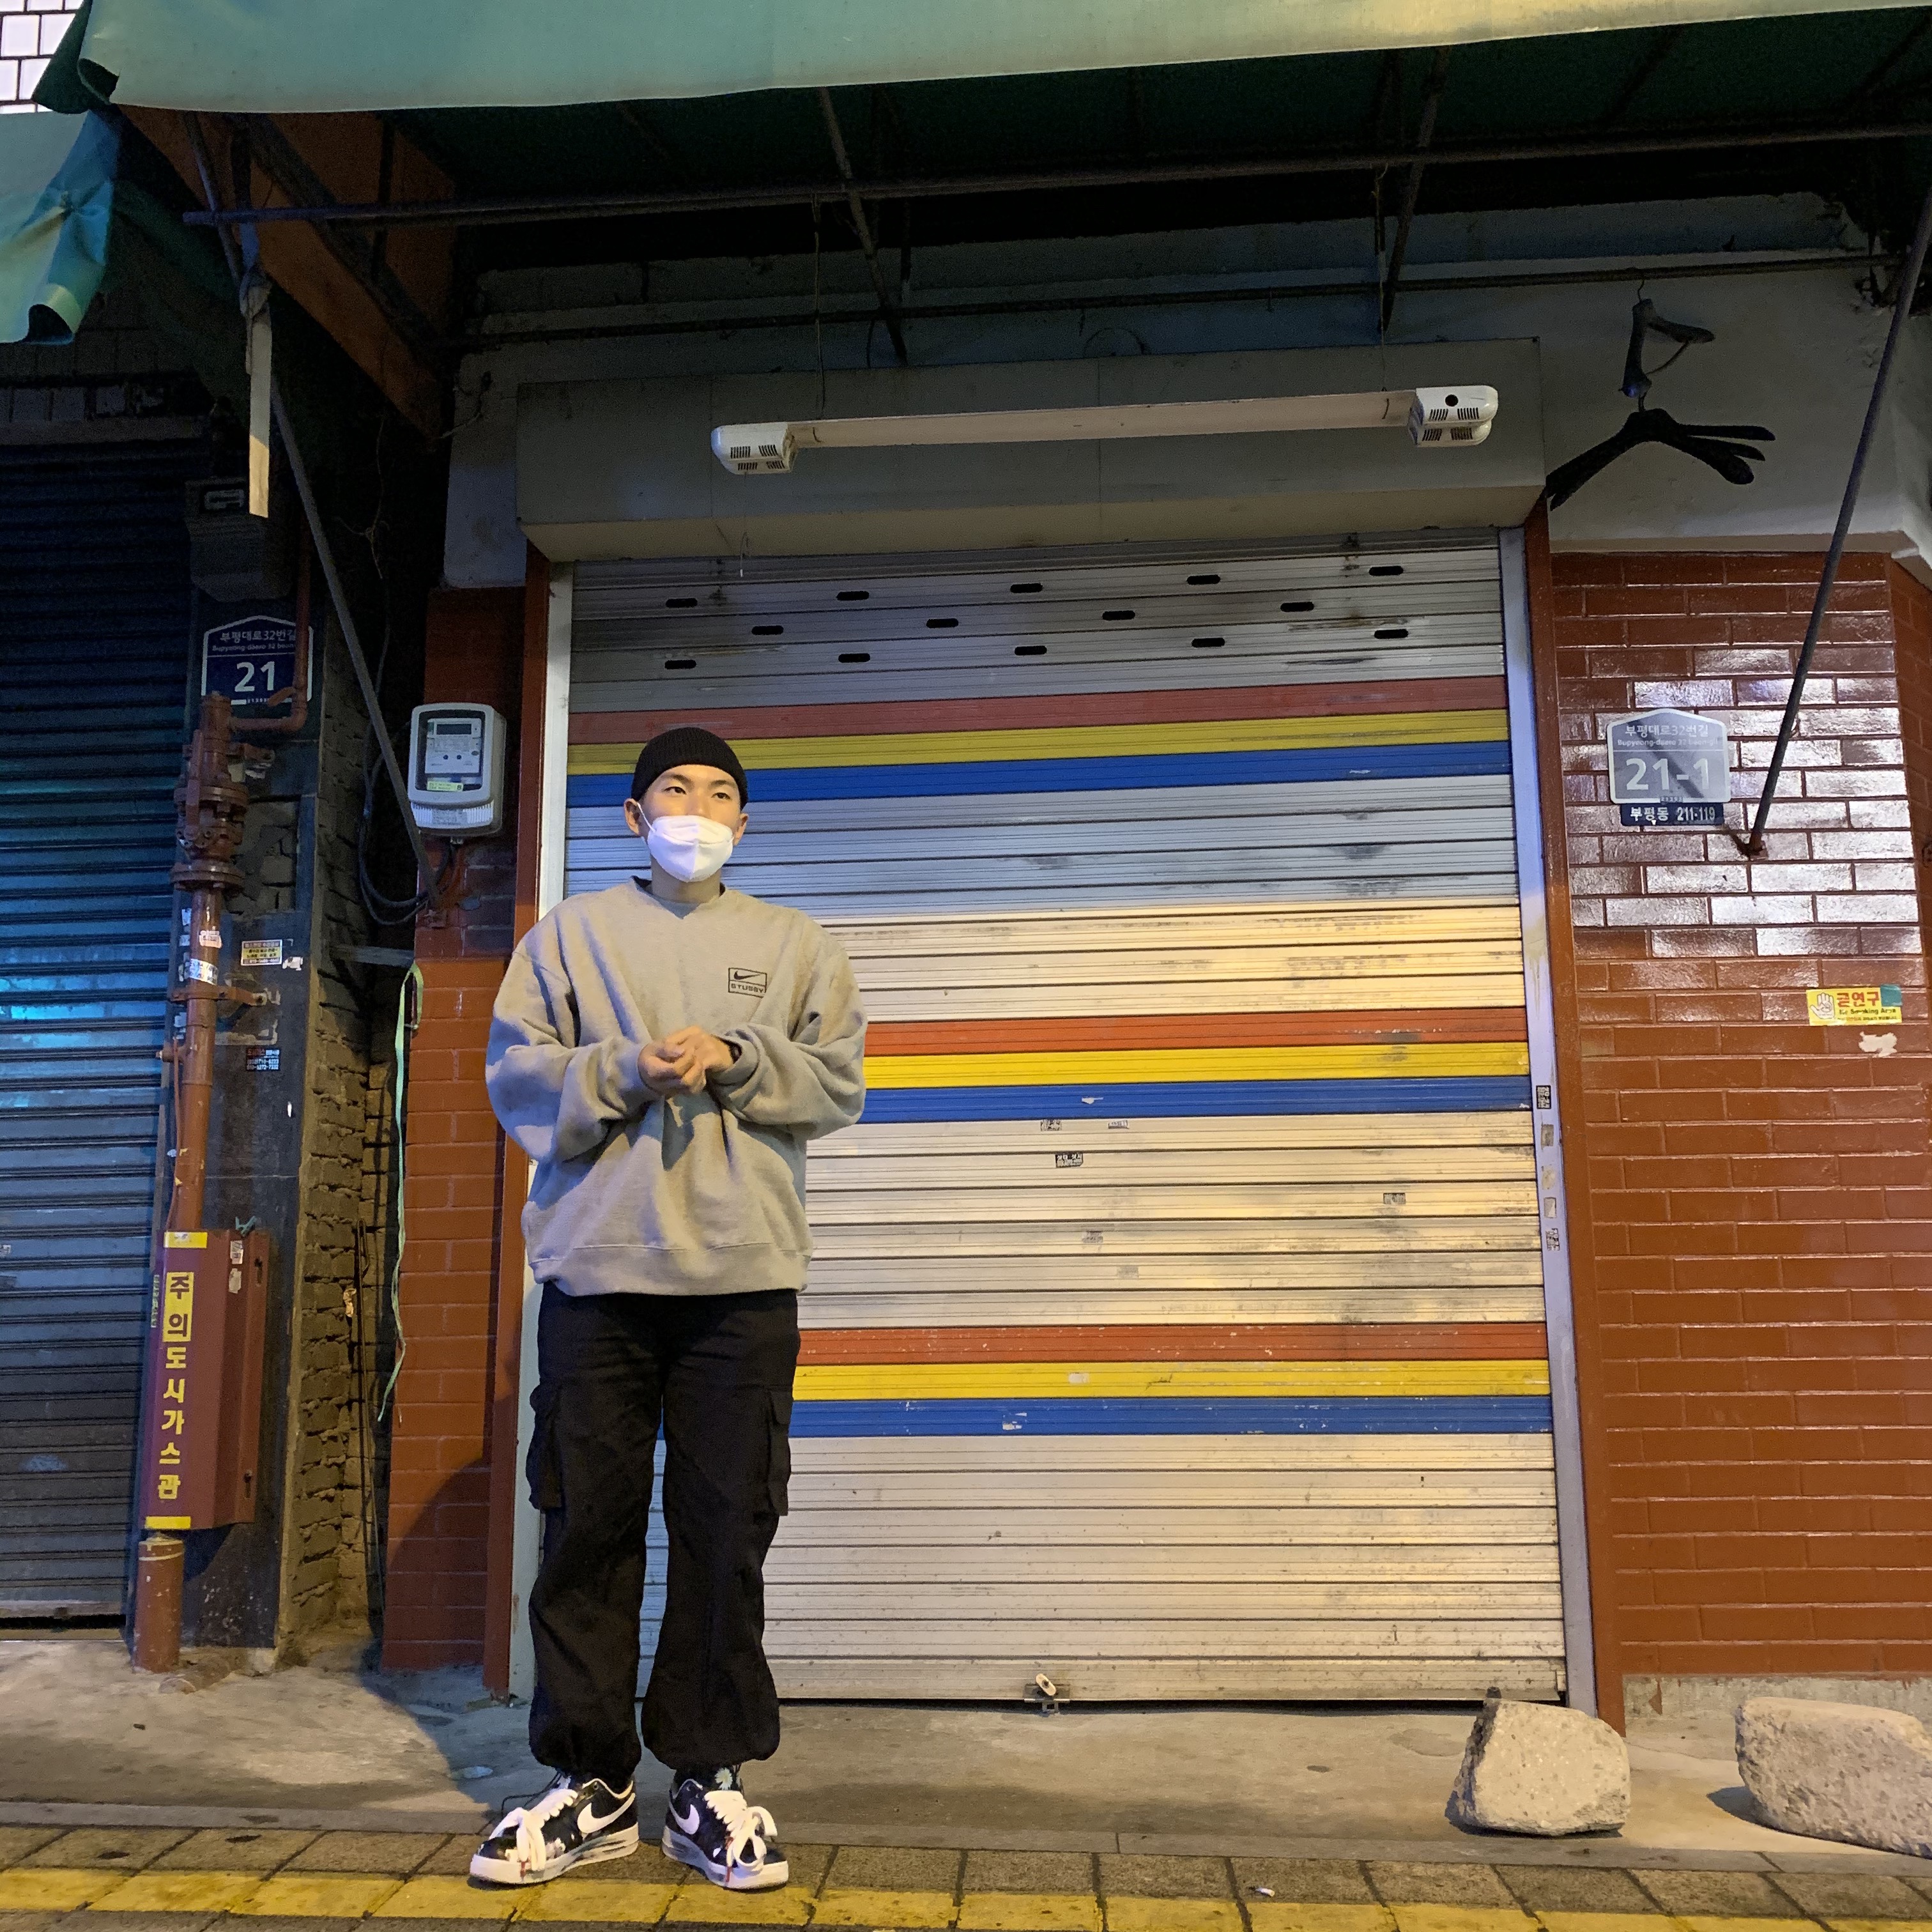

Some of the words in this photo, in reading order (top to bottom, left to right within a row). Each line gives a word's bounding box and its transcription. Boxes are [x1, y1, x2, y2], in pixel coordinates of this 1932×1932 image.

[234, 661, 275, 693] 21
[1625, 724, 1708, 738] 부평대로32번길
[1626, 758, 1710, 790] 21-1
[1630, 806, 1669, 822] 부평동
[730, 983, 765, 993] STUSSY
